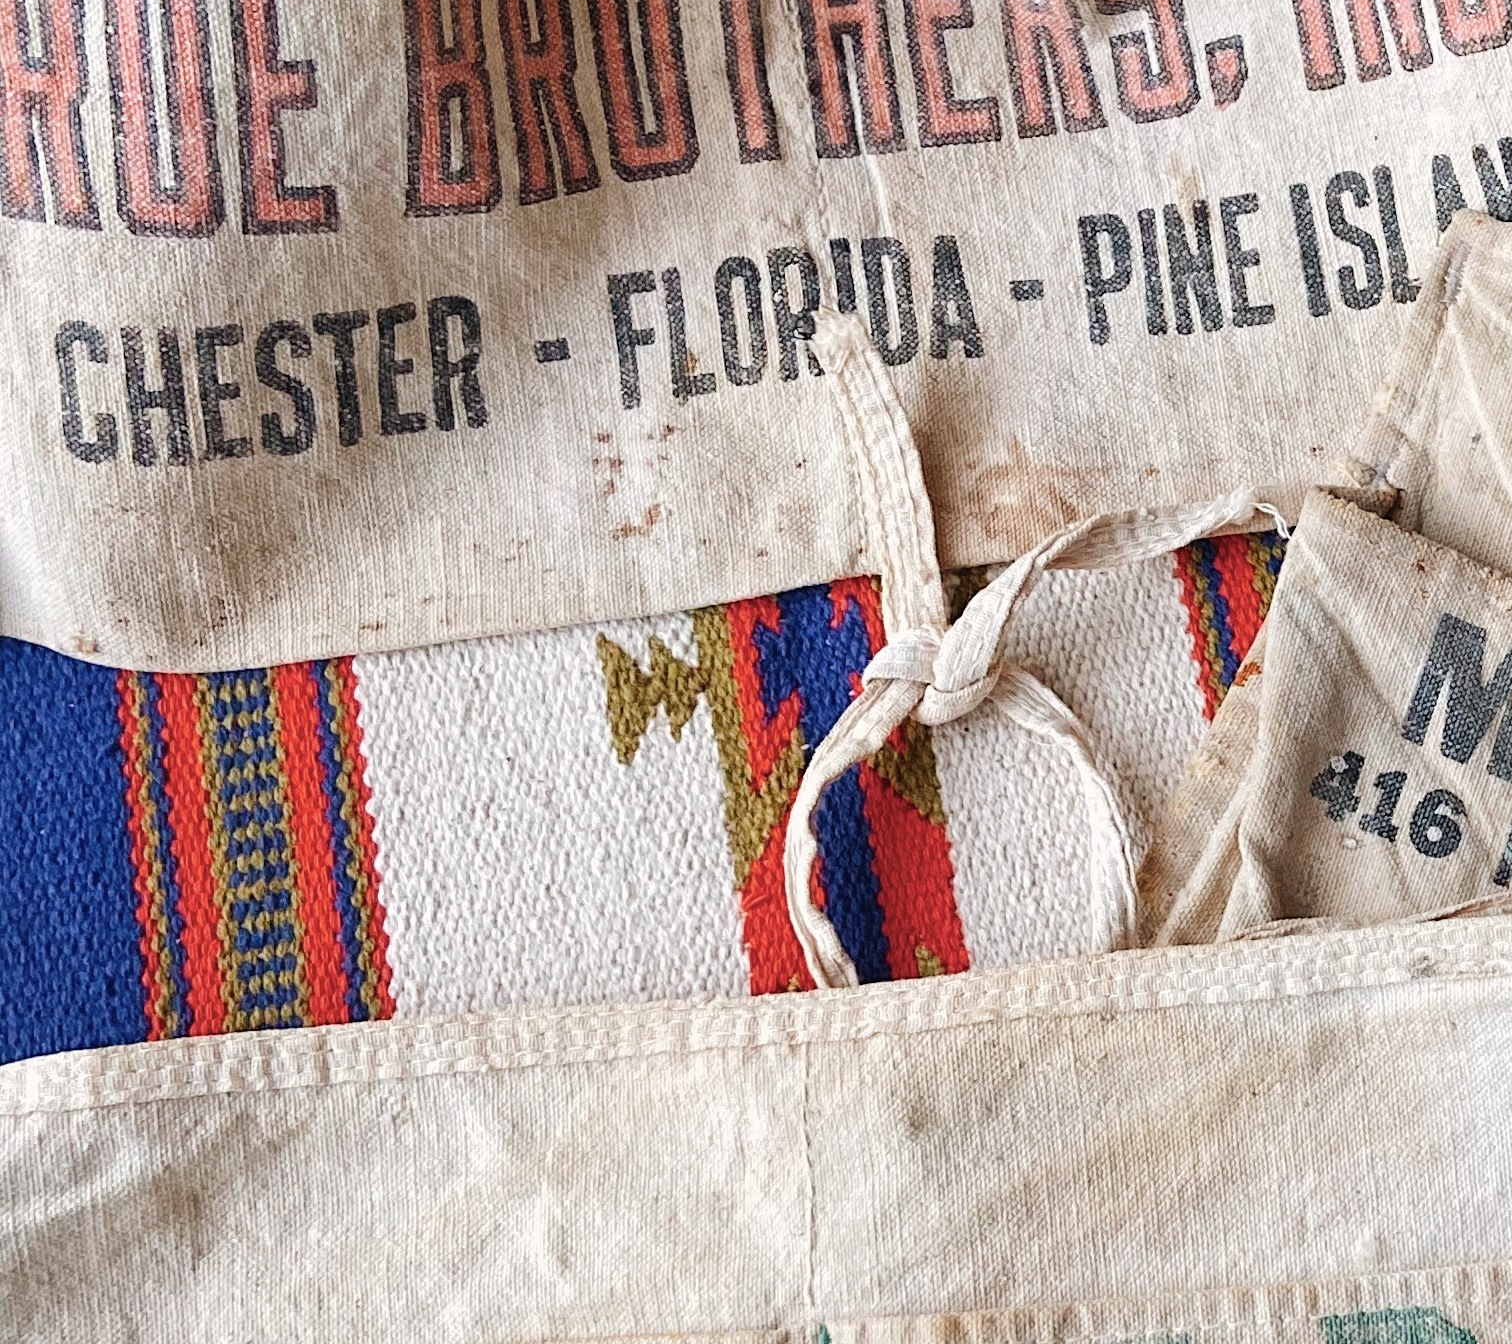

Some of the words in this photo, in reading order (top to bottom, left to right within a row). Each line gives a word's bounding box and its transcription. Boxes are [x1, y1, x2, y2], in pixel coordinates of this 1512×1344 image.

[54, 296, 488, 467] CHESTER
[607, 234, 985, 410] FLORIDA
[1078, 192, 1276, 346] PINE
[1310, 750, 1469, 859] 416
